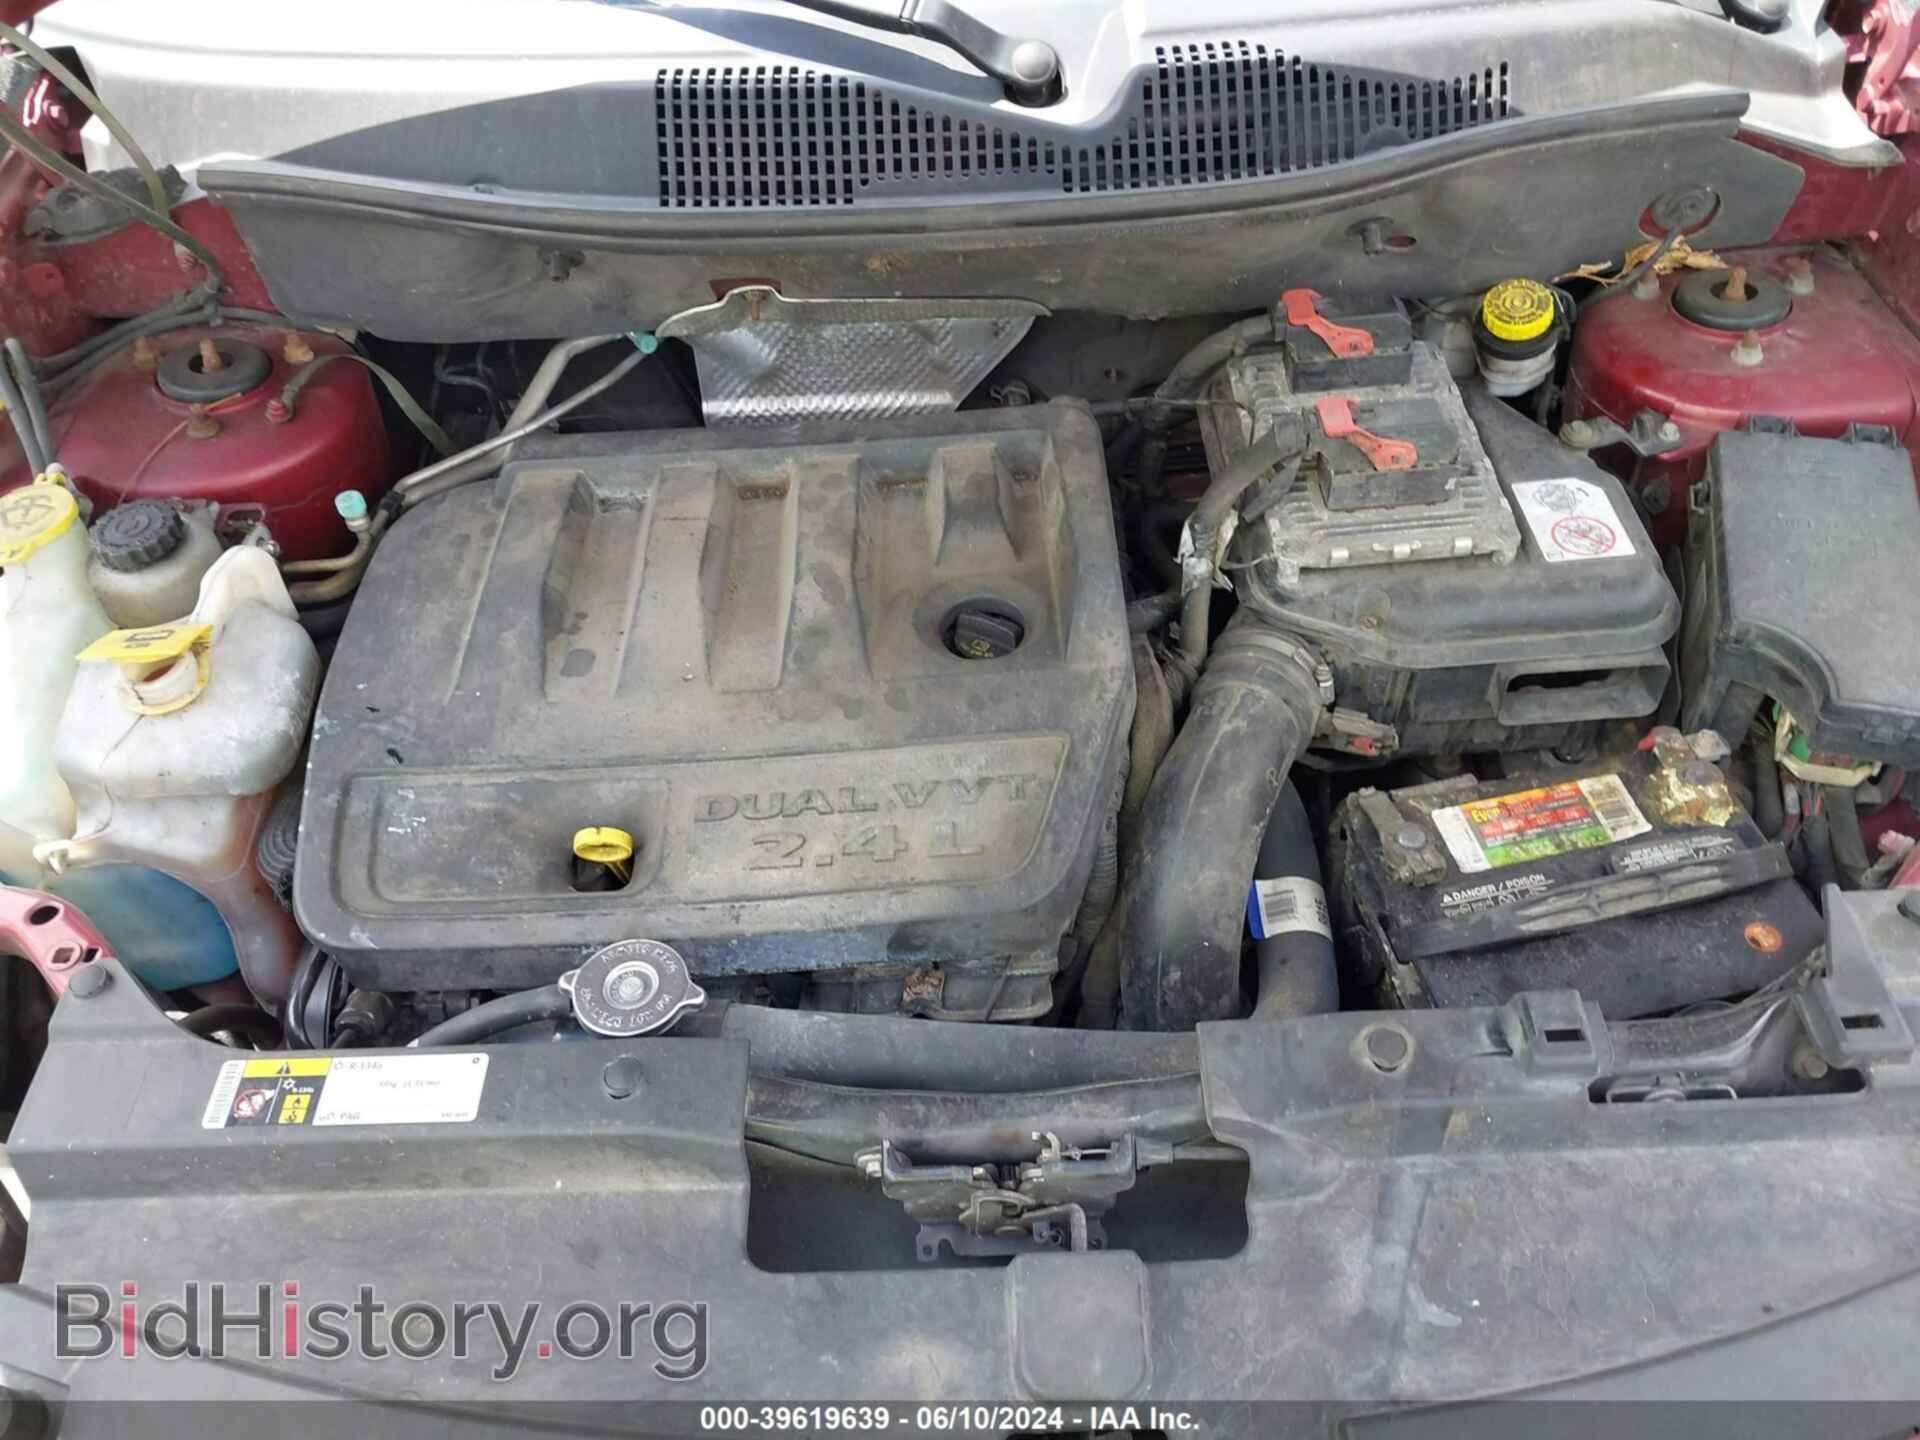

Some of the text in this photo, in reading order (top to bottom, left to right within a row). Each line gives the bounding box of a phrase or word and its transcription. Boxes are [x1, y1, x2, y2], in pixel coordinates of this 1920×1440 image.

[693, 785, 879, 823] DUAL
[1451, 884, 1497, 902] DANGER
[1504, 873, 1546, 890] POISON
